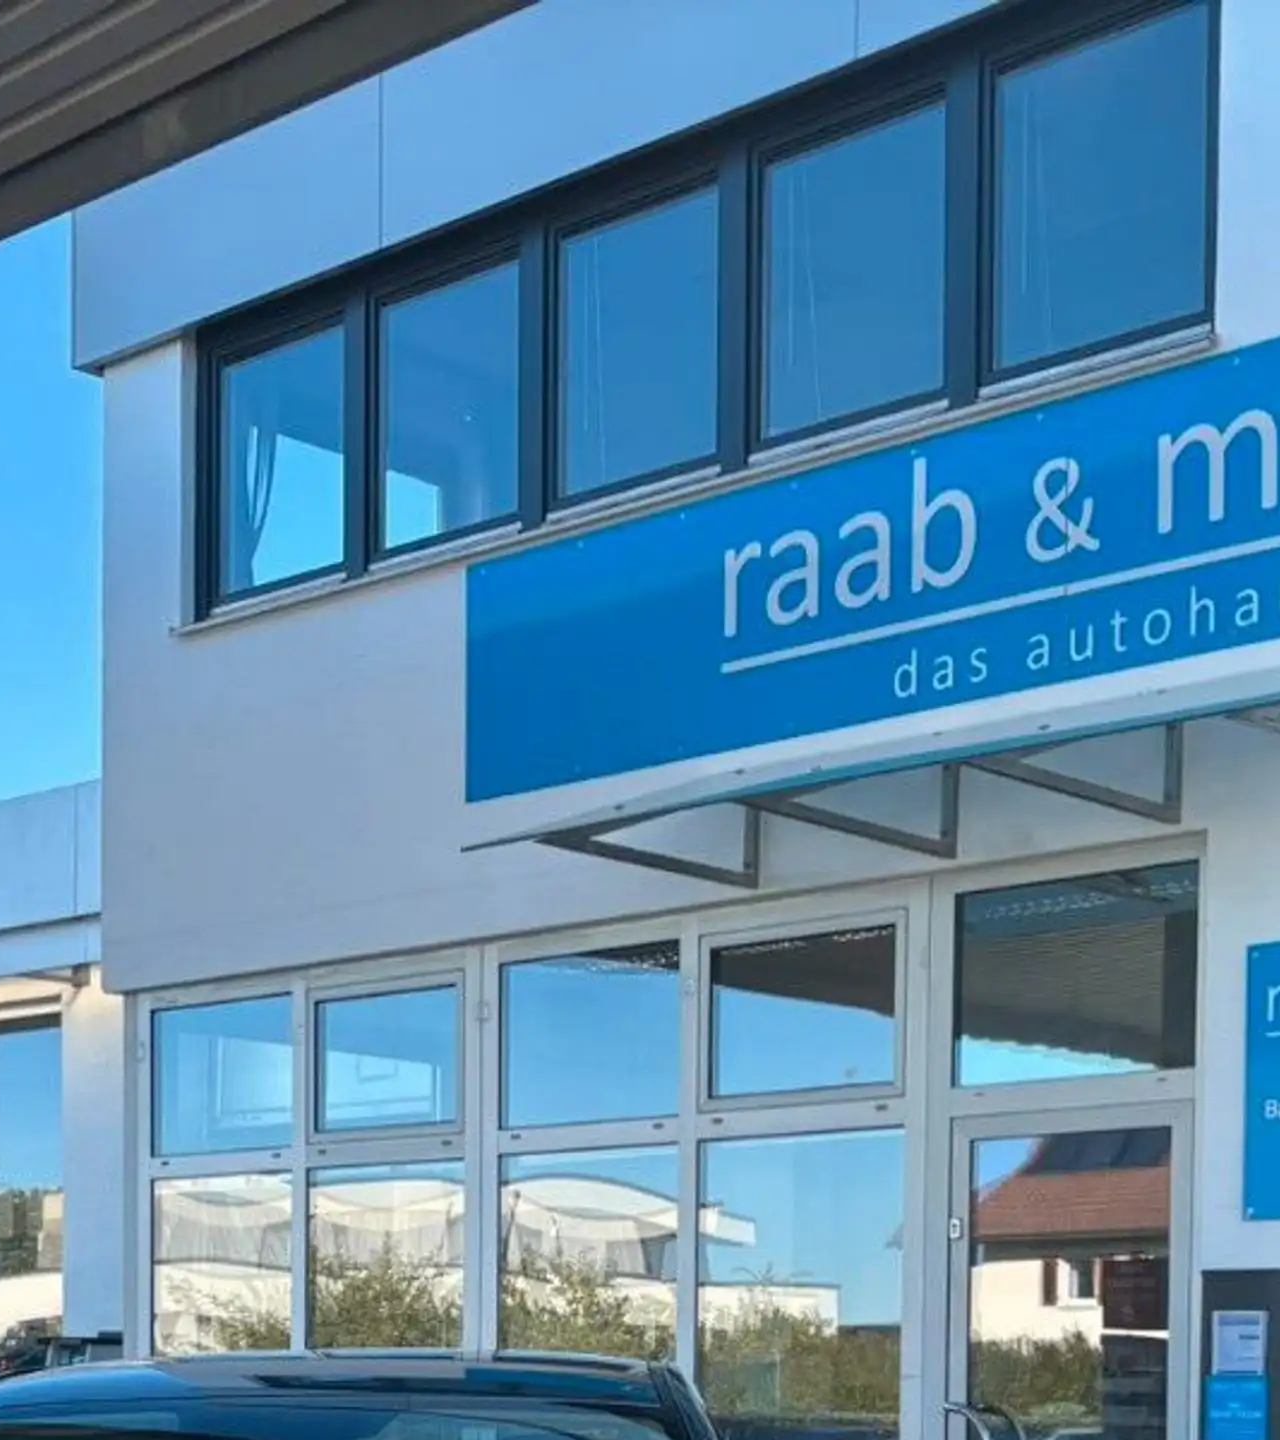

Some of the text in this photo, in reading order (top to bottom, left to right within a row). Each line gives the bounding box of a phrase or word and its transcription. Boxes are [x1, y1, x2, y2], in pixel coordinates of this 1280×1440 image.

[723, 456, 978, 638] raab
[1025, 456, 1101, 563] &
[893, 646, 989, 700] das
